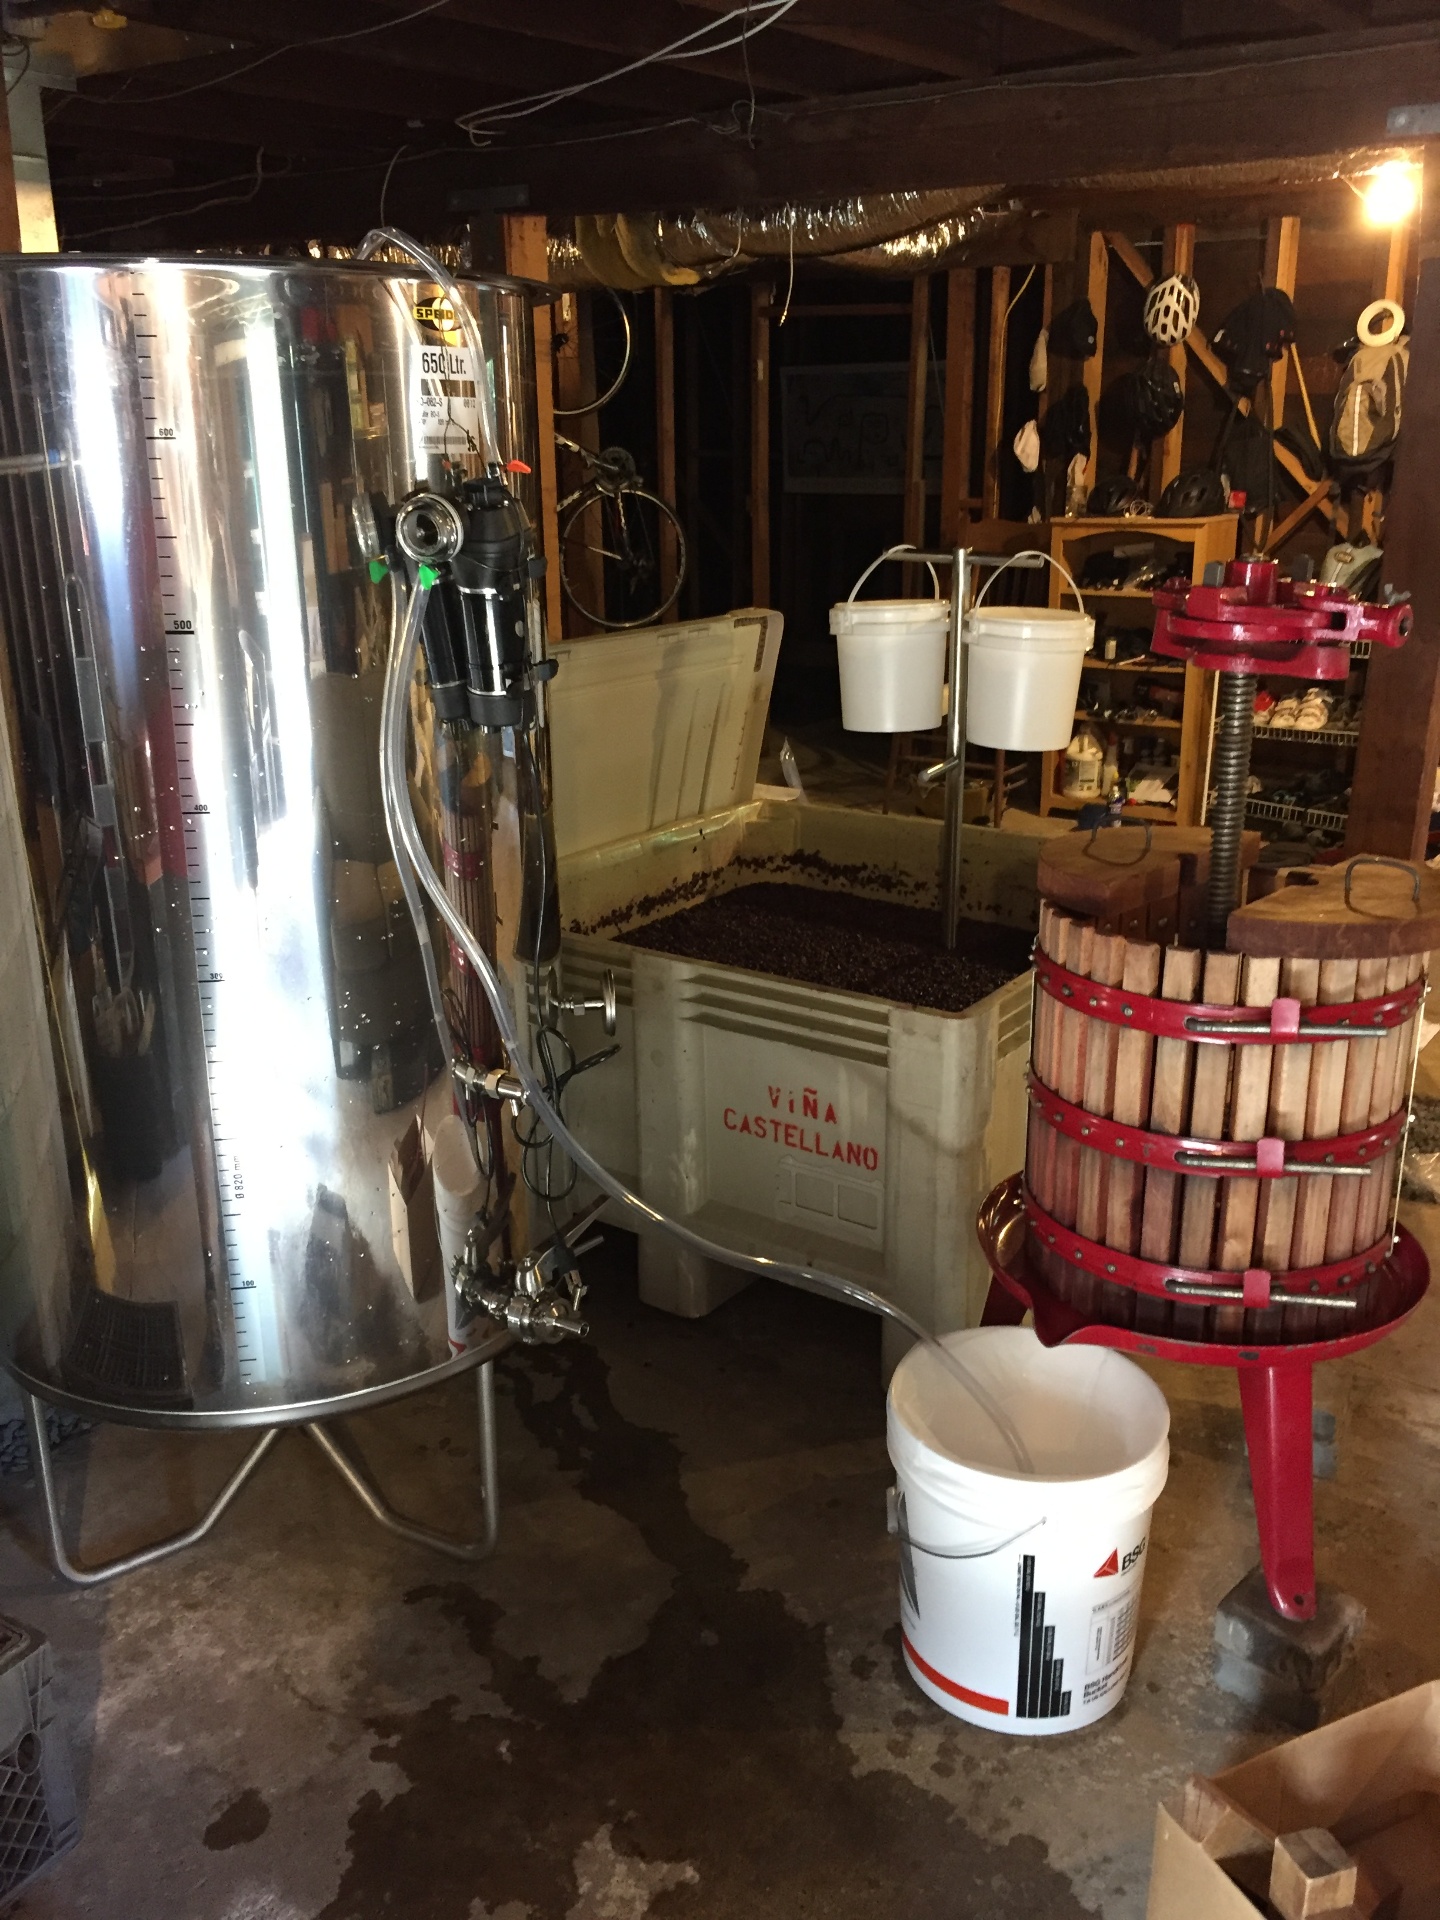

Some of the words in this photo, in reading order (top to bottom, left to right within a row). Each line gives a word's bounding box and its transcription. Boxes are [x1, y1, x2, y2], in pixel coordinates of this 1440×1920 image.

[422, 352, 445, 374] 650
[449, 353, 467, 375] Ltr.
[159, 428, 174, 436] 600
[173, 620, 192, 629] 500
[723, 1107, 879, 1171] CASTELLANO
[233, 1173, 244, 1190] 820
[1121, 1536, 1146, 1571] BSG
